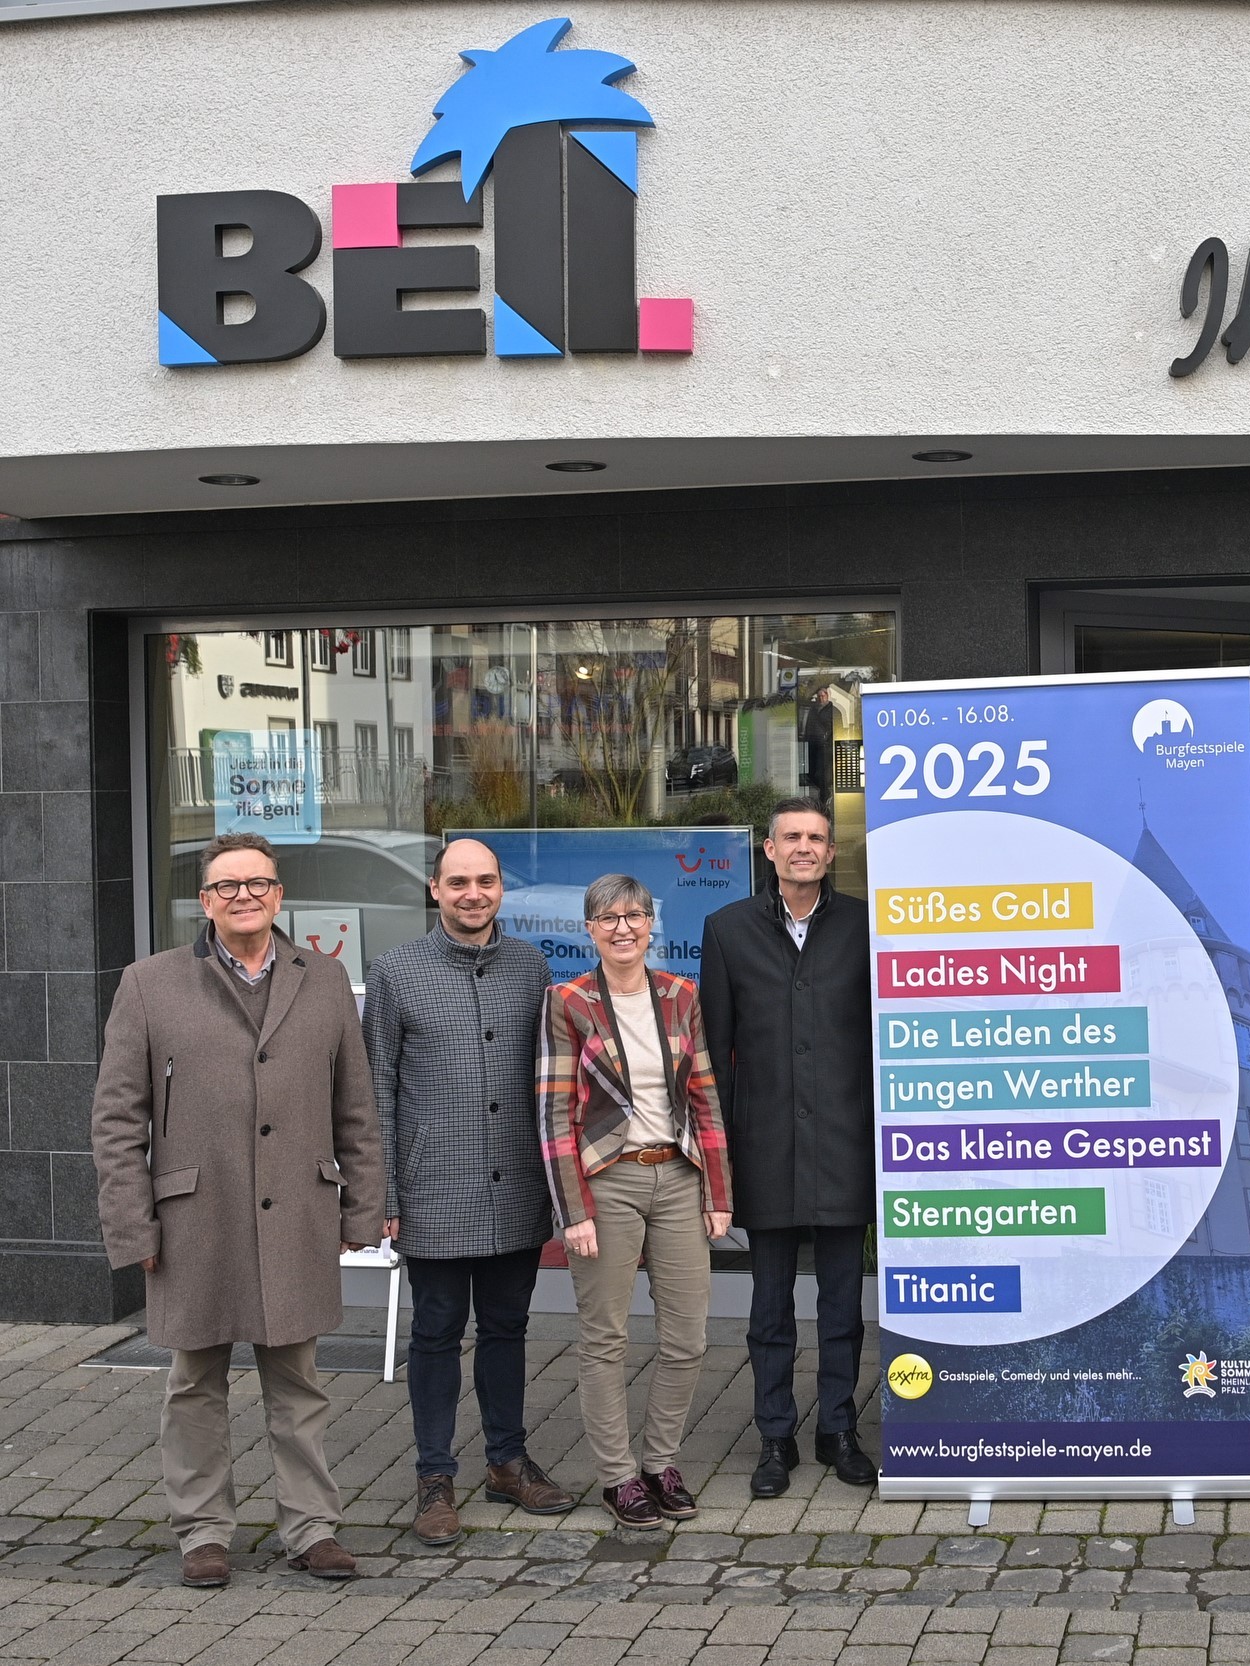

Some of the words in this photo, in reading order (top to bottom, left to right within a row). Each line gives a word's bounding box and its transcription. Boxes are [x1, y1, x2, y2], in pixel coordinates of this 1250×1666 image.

[877, 709, 935, 728] 01.06.
[957, 705, 1015, 724] 16.08.
[1155, 741, 1245, 758] Burgfestspiele
[230, 759, 266, 770] Jetzt
[270, 759, 280, 769] in
[879, 739, 1051, 800] 2025
[1165, 757, 1205, 771] Mayen
[229, 774, 306, 796] Sonne
[236, 801, 300, 820] fliegen!
[709, 859, 730, 870] TUI
[677, 877, 697, 887] Live
[699, 877, 730, 889] Happy
[888, 891, 981, 923] Süßes
[992, 888, 1070, 921] Gold
[513, 914, 584, 933] Winter
[891, 955, 989, 988] Ladies
[1000, 952, 1088, 992] Night
[888, 1020, 938, 1049] Die
[950, 1015, 1051, 1047] Leiden
[1062, 1013, 1117, 1044] des
[888, 1073, 993, 1110] jungen
[1004, 1067, 1136, 1099] Werther
[891, 1132, 950, 1162] Das
[960, 1129, 1052, 1160] kleine
[1062, 1129, 1211, 1167] Gespenst
[892, 1197, 1077, 1234] Sterngarten
[892, 1274, 995, 1303] Titanic
[938, 1368, 998, 1384] Gastspiele,
[1001, 1368, 1047, 1384] Comedy
[1049, 1368, 1070, 1382] und
[1072, 1367, 1103, 1381] vieles
[1105, 1367, 1142, 1381] mehr...
[1221, 1386, 1246, 1395] PFALZ
[889, 1438, 1152, 1462] www.burgfestspiele-mayen.de
